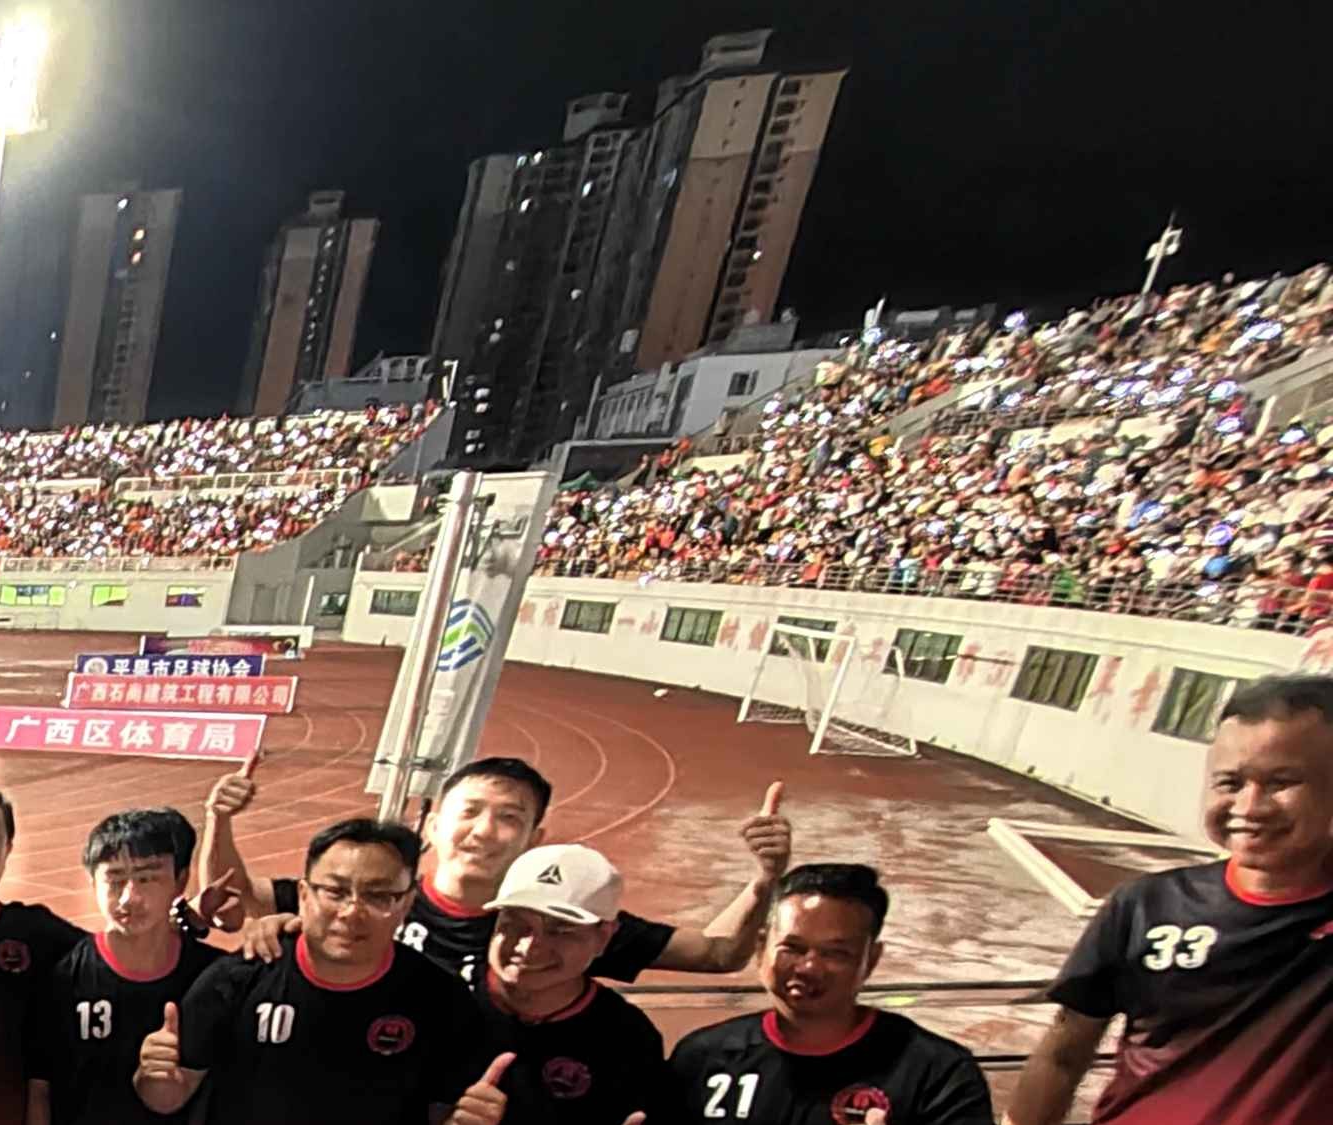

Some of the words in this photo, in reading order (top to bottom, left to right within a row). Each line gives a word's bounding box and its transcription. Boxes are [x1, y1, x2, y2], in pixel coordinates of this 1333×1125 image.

[4, 715, 237, 753] 广西区体育局
[1144, 925, 1218, 970] 33
[76, 999, 113, 1040] 13
[256, 1002, 295, 1044] 10
[703, 1073, 759, 1119] 21
